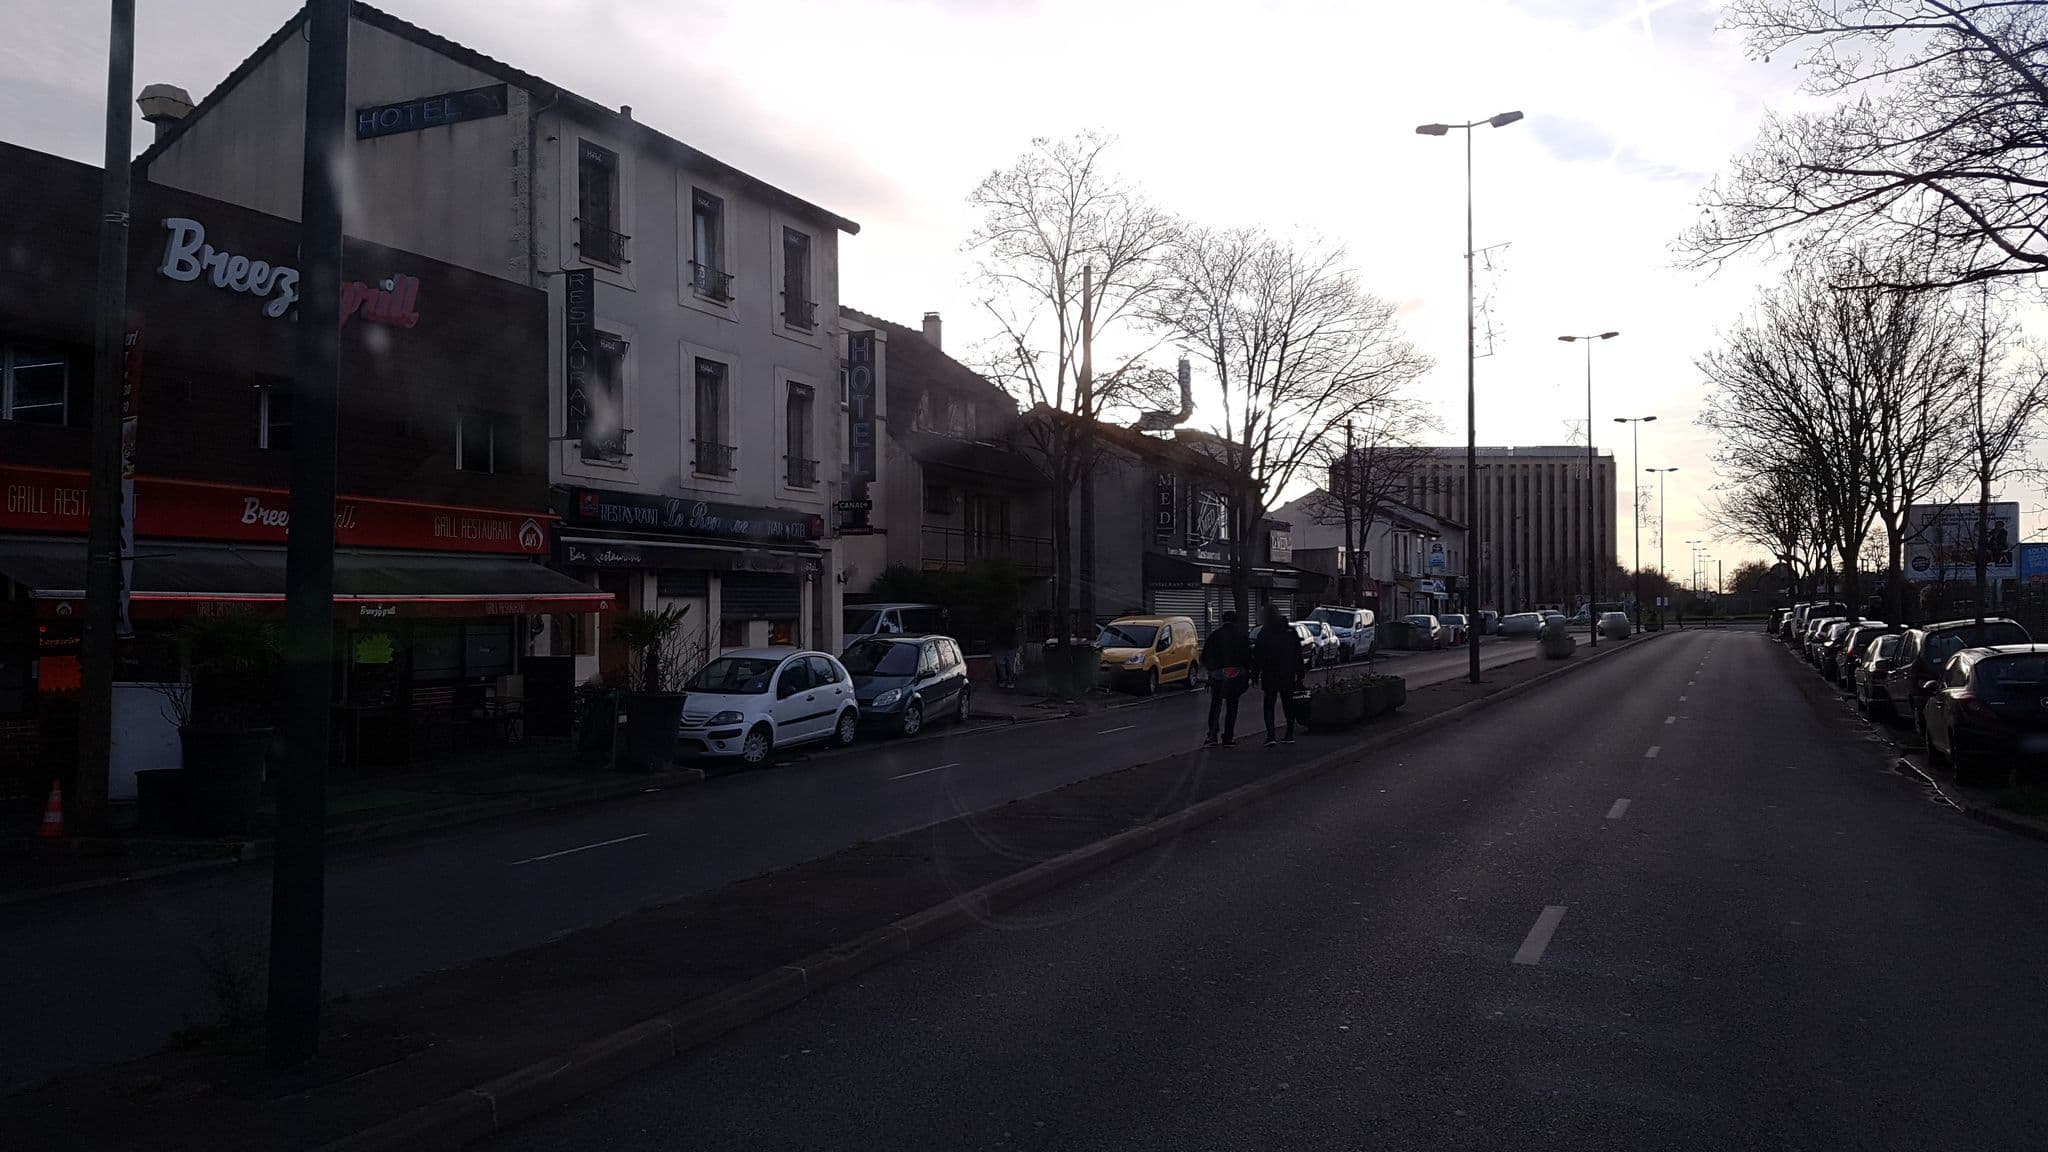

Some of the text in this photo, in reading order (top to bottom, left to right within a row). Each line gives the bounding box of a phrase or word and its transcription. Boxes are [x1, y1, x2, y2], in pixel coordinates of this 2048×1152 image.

[359, 97, 459, 132] HOTEL
[158, 217, 301, 319] Breez
[568, 272, 588, 433] RESTAURANT
[851, 336, 872, 476] HOTEL
[7, 483, 48, 514] GRILL
[839, 501, 869, 510] CANAL+
[1157, 473, 1172, 525] MED
[432, 515, 514, 541] GRILL RESTAURANT
[568, 546, 587, 562] Bar
